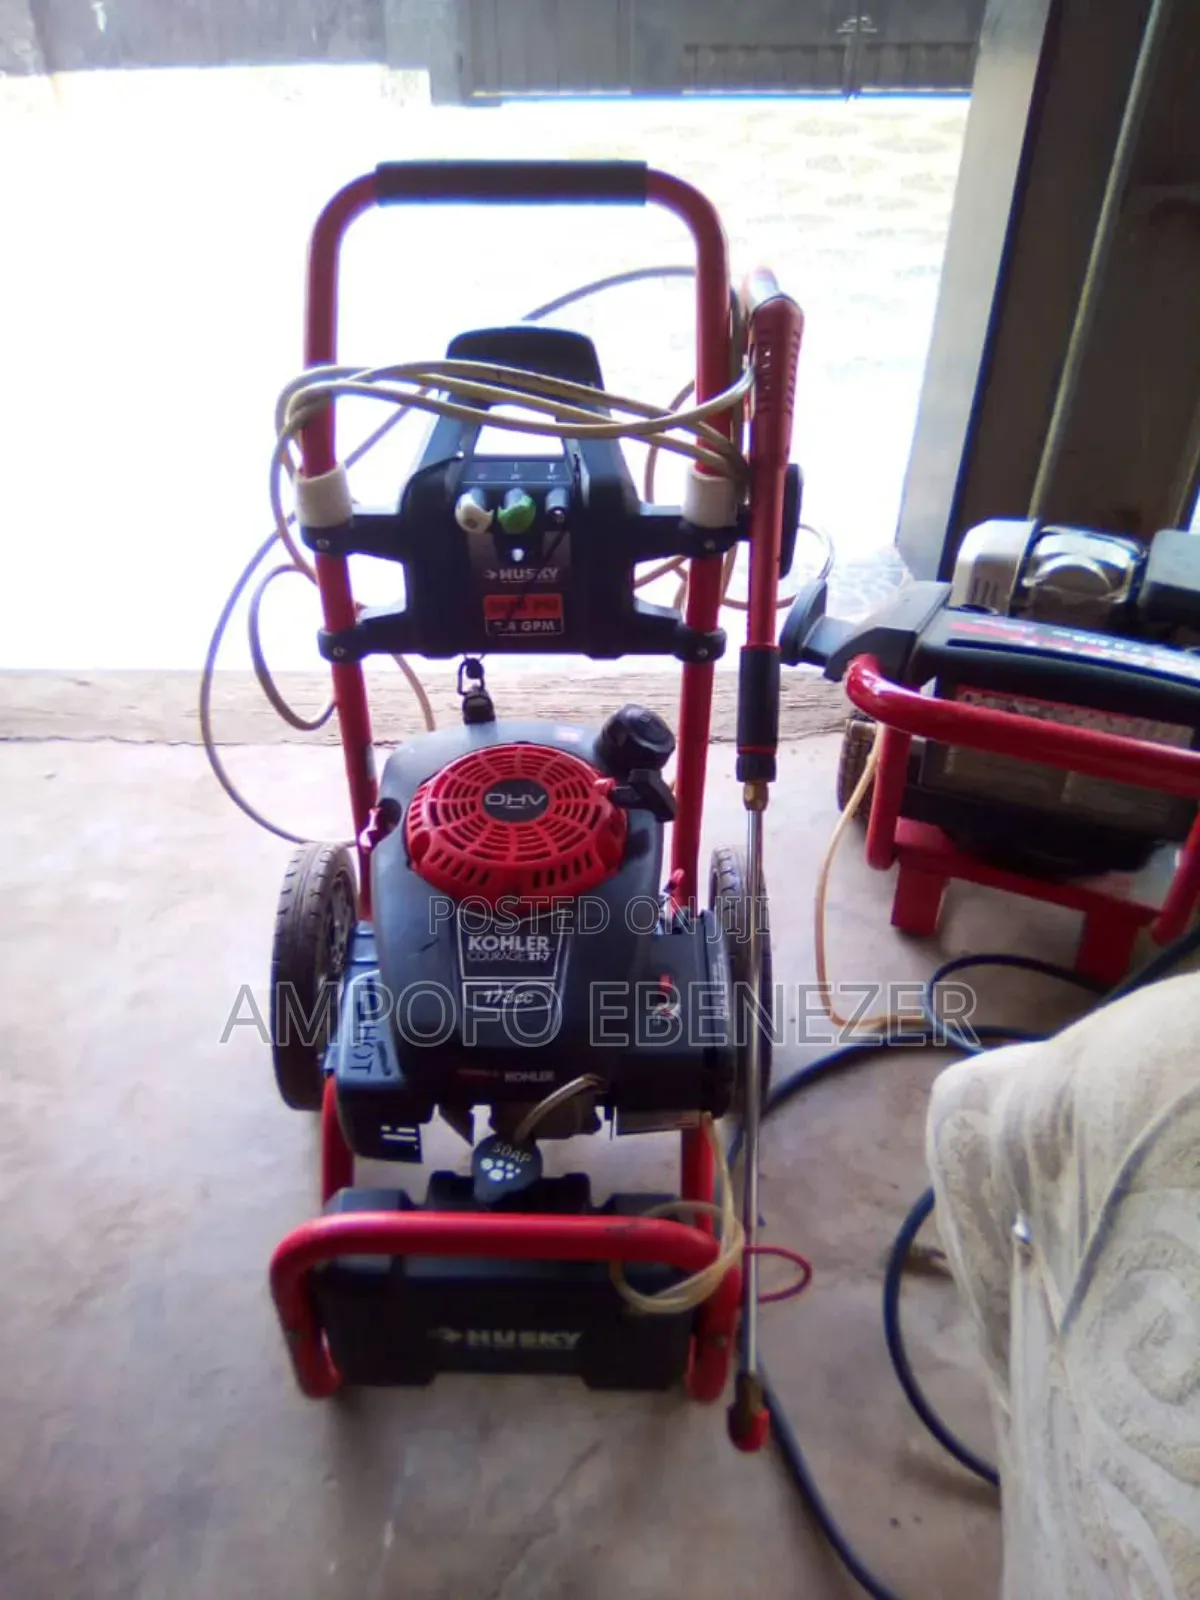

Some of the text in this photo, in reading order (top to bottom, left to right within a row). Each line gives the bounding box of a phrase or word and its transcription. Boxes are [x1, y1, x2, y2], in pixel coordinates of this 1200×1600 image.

[520, 620, 556, 632] GPM
[485, 793, 546, 806] OHV
[468, 935, 550, 951] KOHLER
